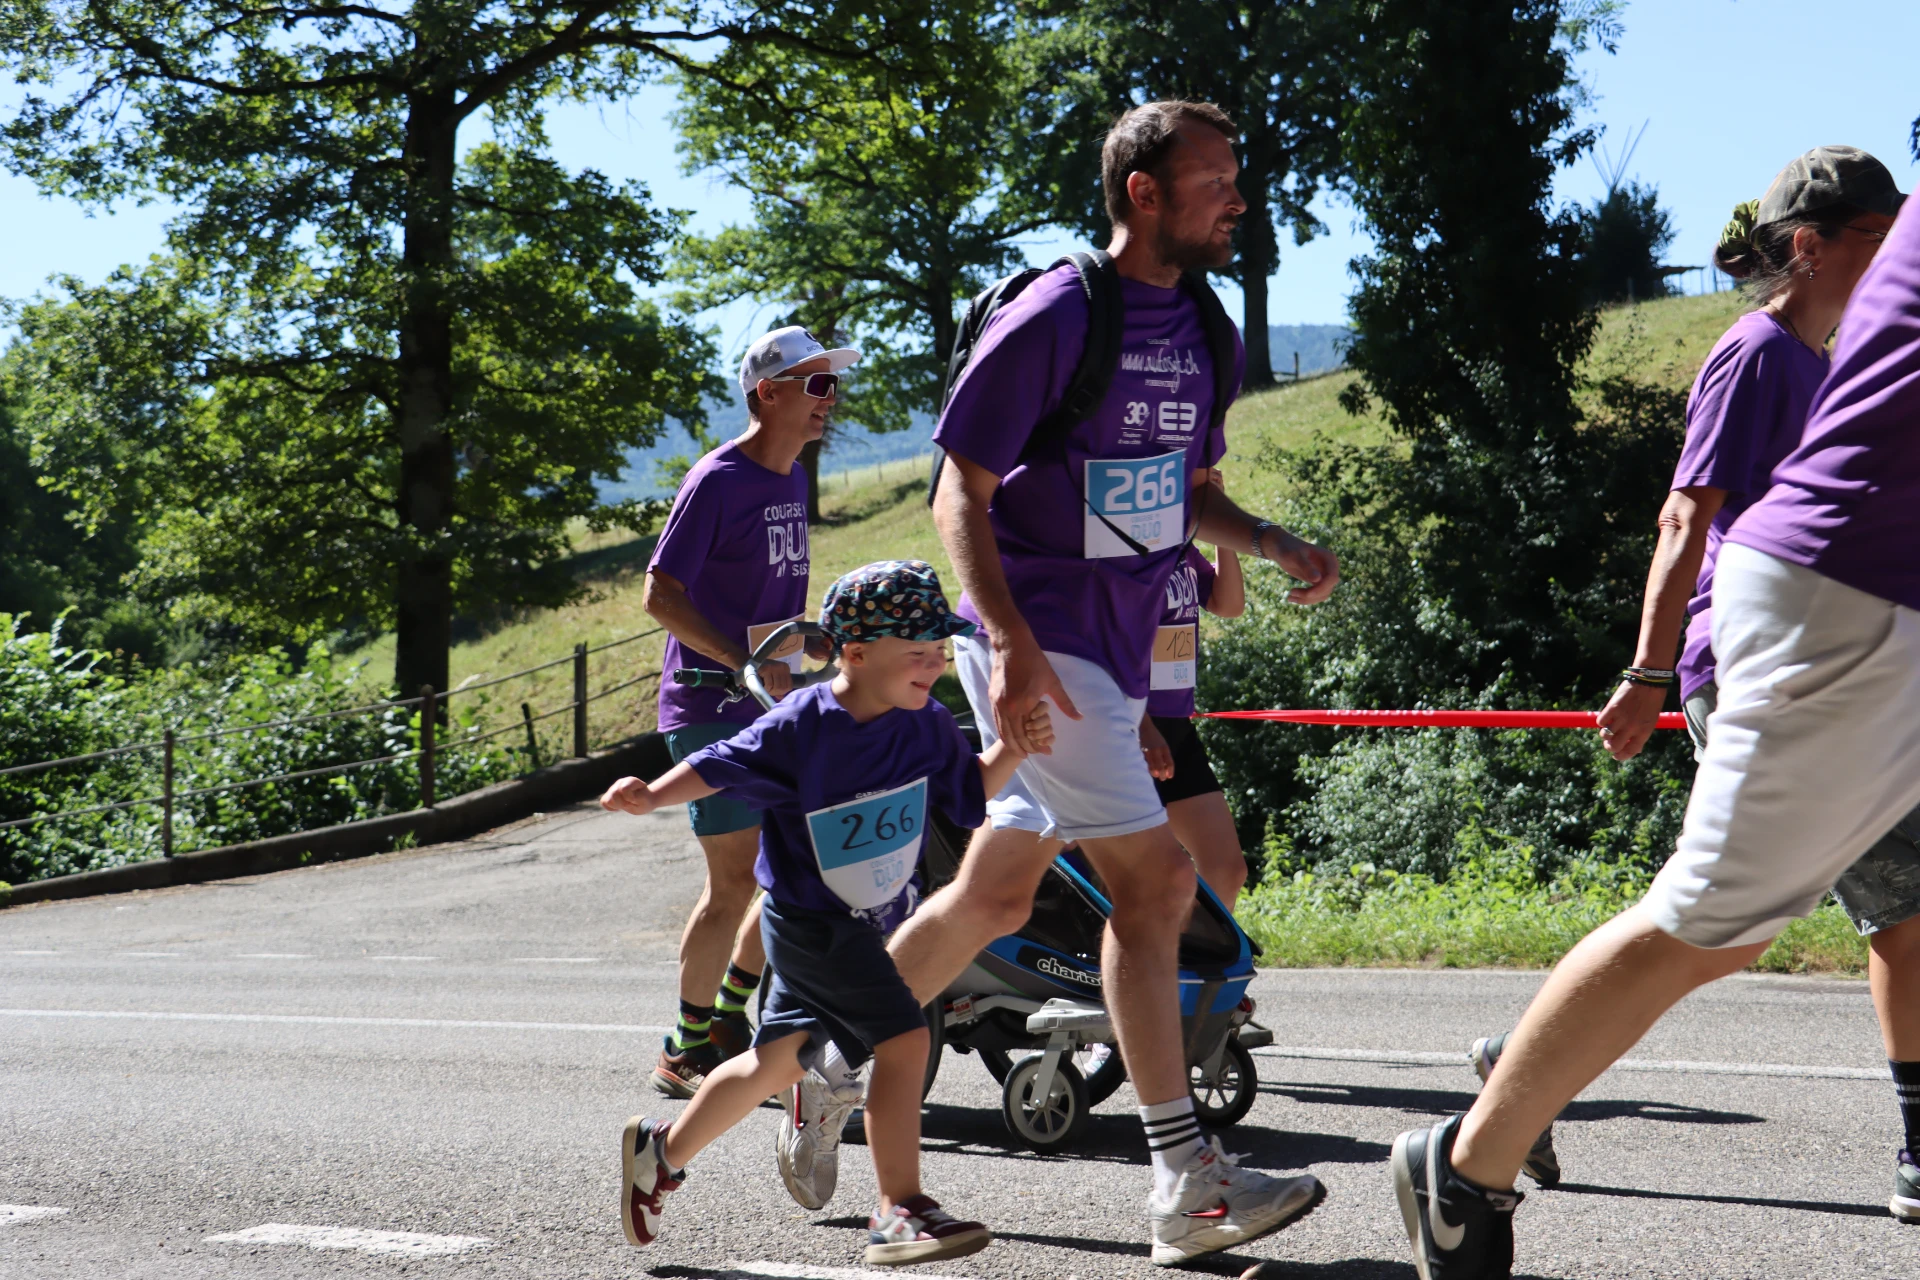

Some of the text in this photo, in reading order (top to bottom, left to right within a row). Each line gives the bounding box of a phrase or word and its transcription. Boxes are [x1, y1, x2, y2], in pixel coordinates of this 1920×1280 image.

[1104, 461, 1176, 511] 266
[764, 503, 802, 521] COURSE
[1131, 521, 1162, 541] DUO
[1166, 630, 1192, 659] 125
[841, 804, 914, 850] 266
[872, 859, 904, 888] DUO
[1037, 957, 1102, 987] chario
